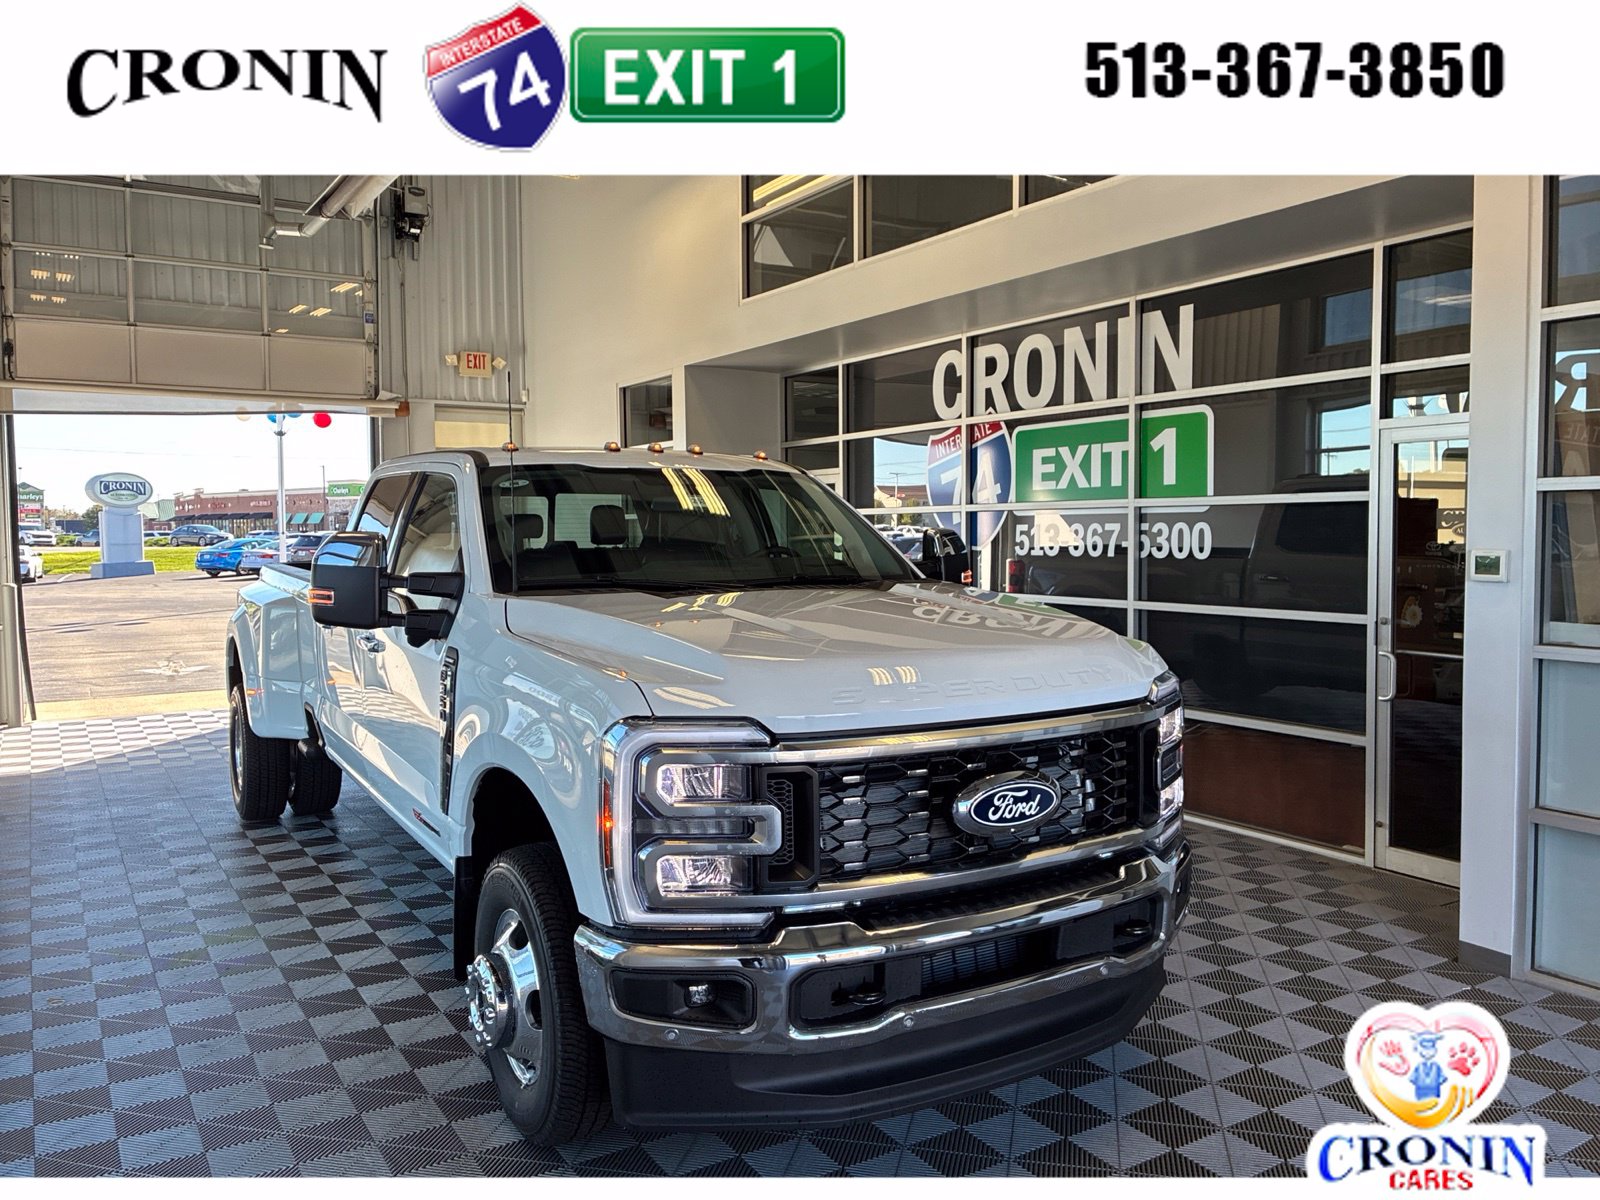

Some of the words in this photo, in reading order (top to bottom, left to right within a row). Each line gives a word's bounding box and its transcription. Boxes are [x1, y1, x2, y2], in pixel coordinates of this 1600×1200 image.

[466, 353, 487, 370] EXIT
[932, 304, 1194, 420] CRONIN
[935, 422, 993, 459] INTERATE
[1032, 441, 1130, 491] EXIT
[1150, 427, 1177, 485] 1
[101, 481, 146, 495] CRONIN
[940, 451, 1001, 524] 74
[1014, 521, 1213, 561] 513-367-5300
[1011, 664, 1113, 692] DUTY
[988, 790, 1041, 821] Ford
